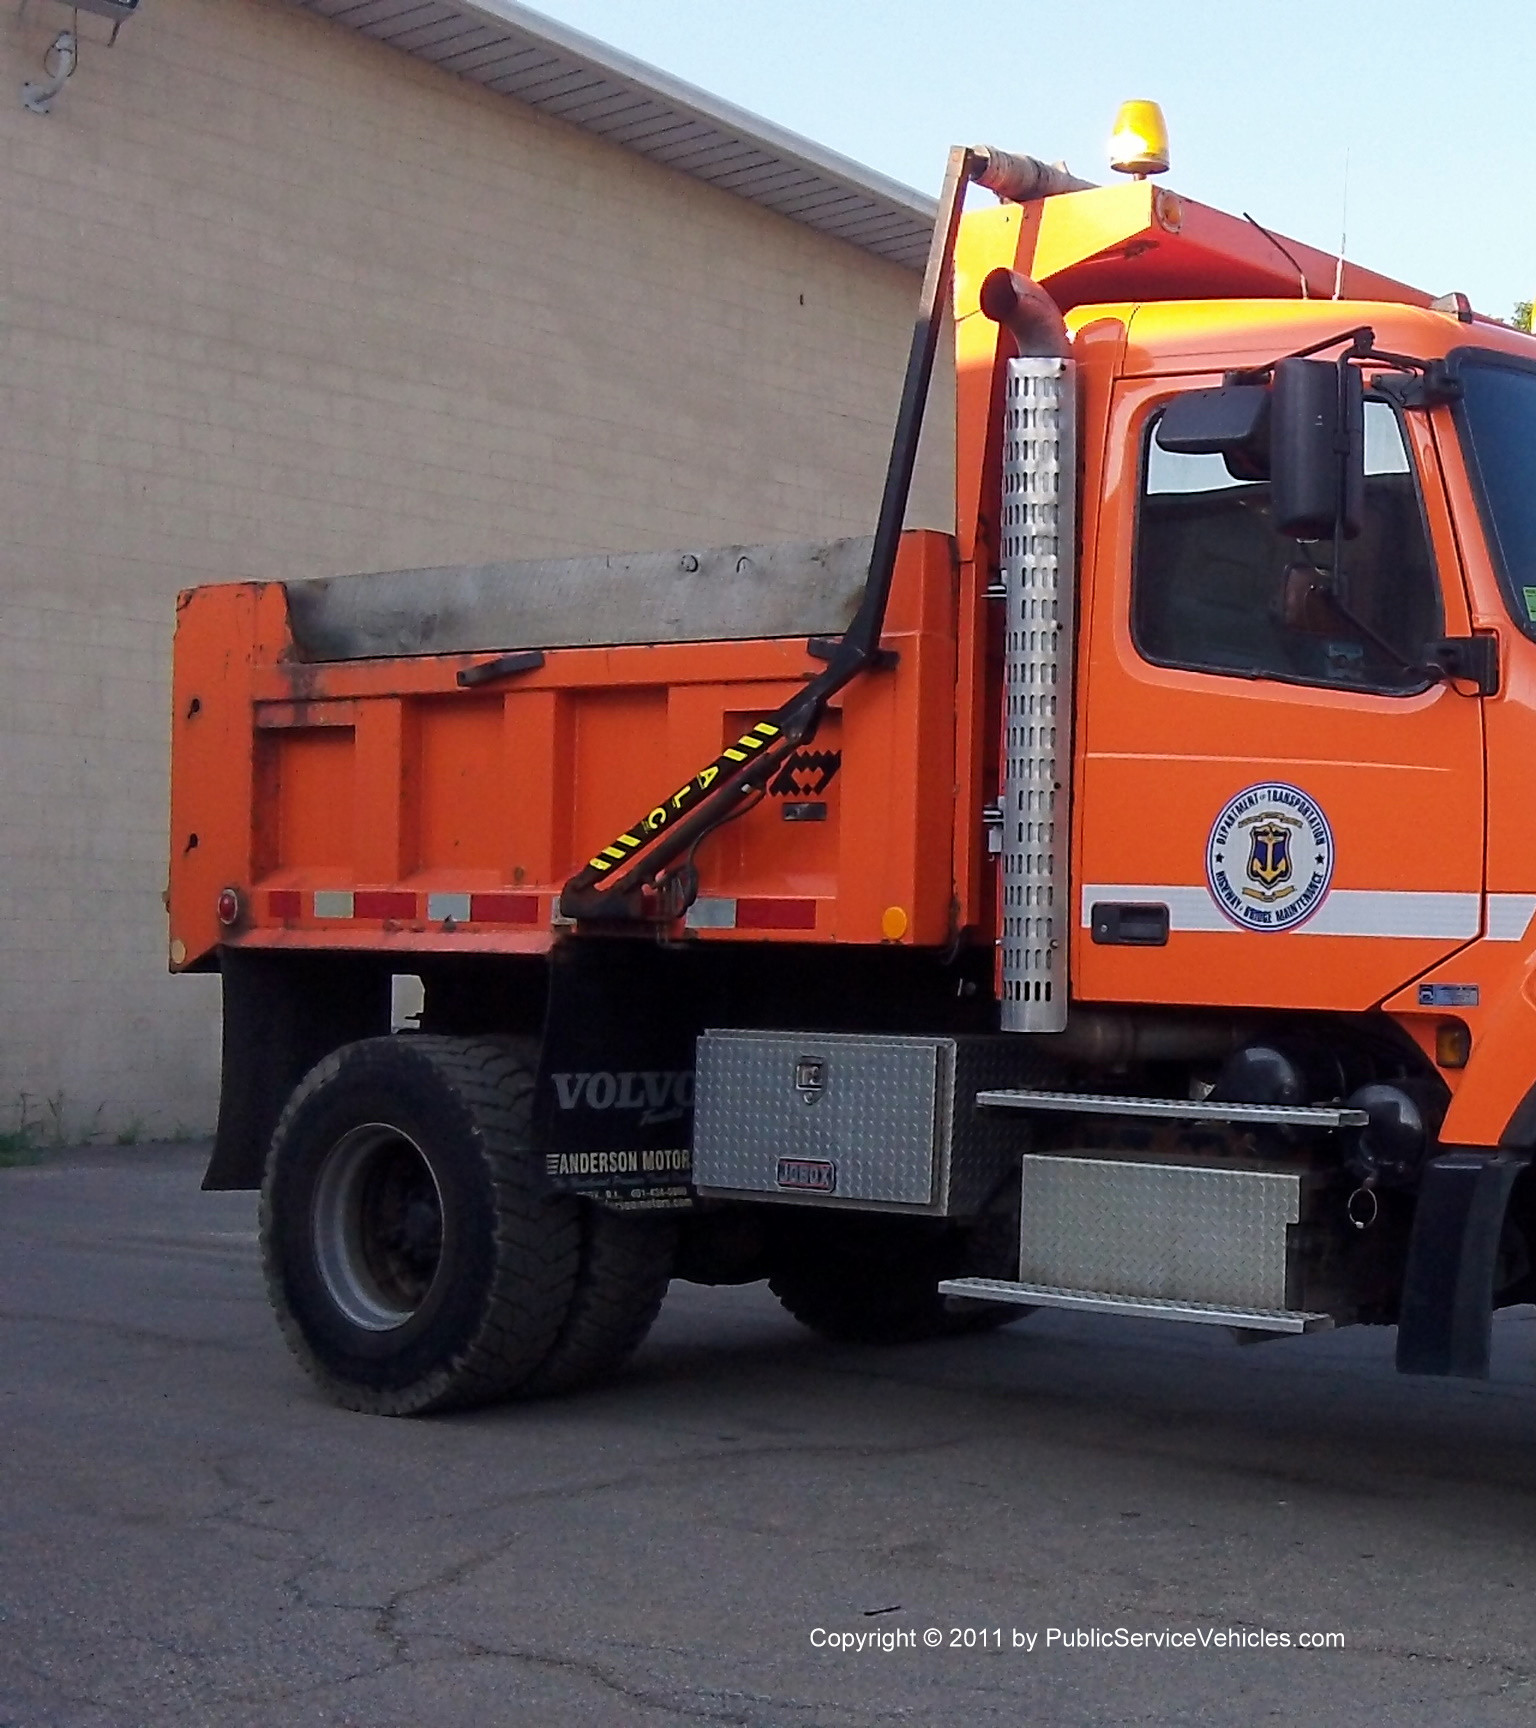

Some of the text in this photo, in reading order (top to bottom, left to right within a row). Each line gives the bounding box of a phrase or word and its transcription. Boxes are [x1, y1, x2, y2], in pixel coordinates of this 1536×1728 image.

[1216, 792, 1259, 846] DEPARTMENT
[1267, 789, 1327, 847] TRANSPORTATION
[1276, 871, 1324, 921] MAINTENANCE
[551, 1071, 695, 1110] VOLVO
[559, 1151, 638, 1175] ANDERSON
